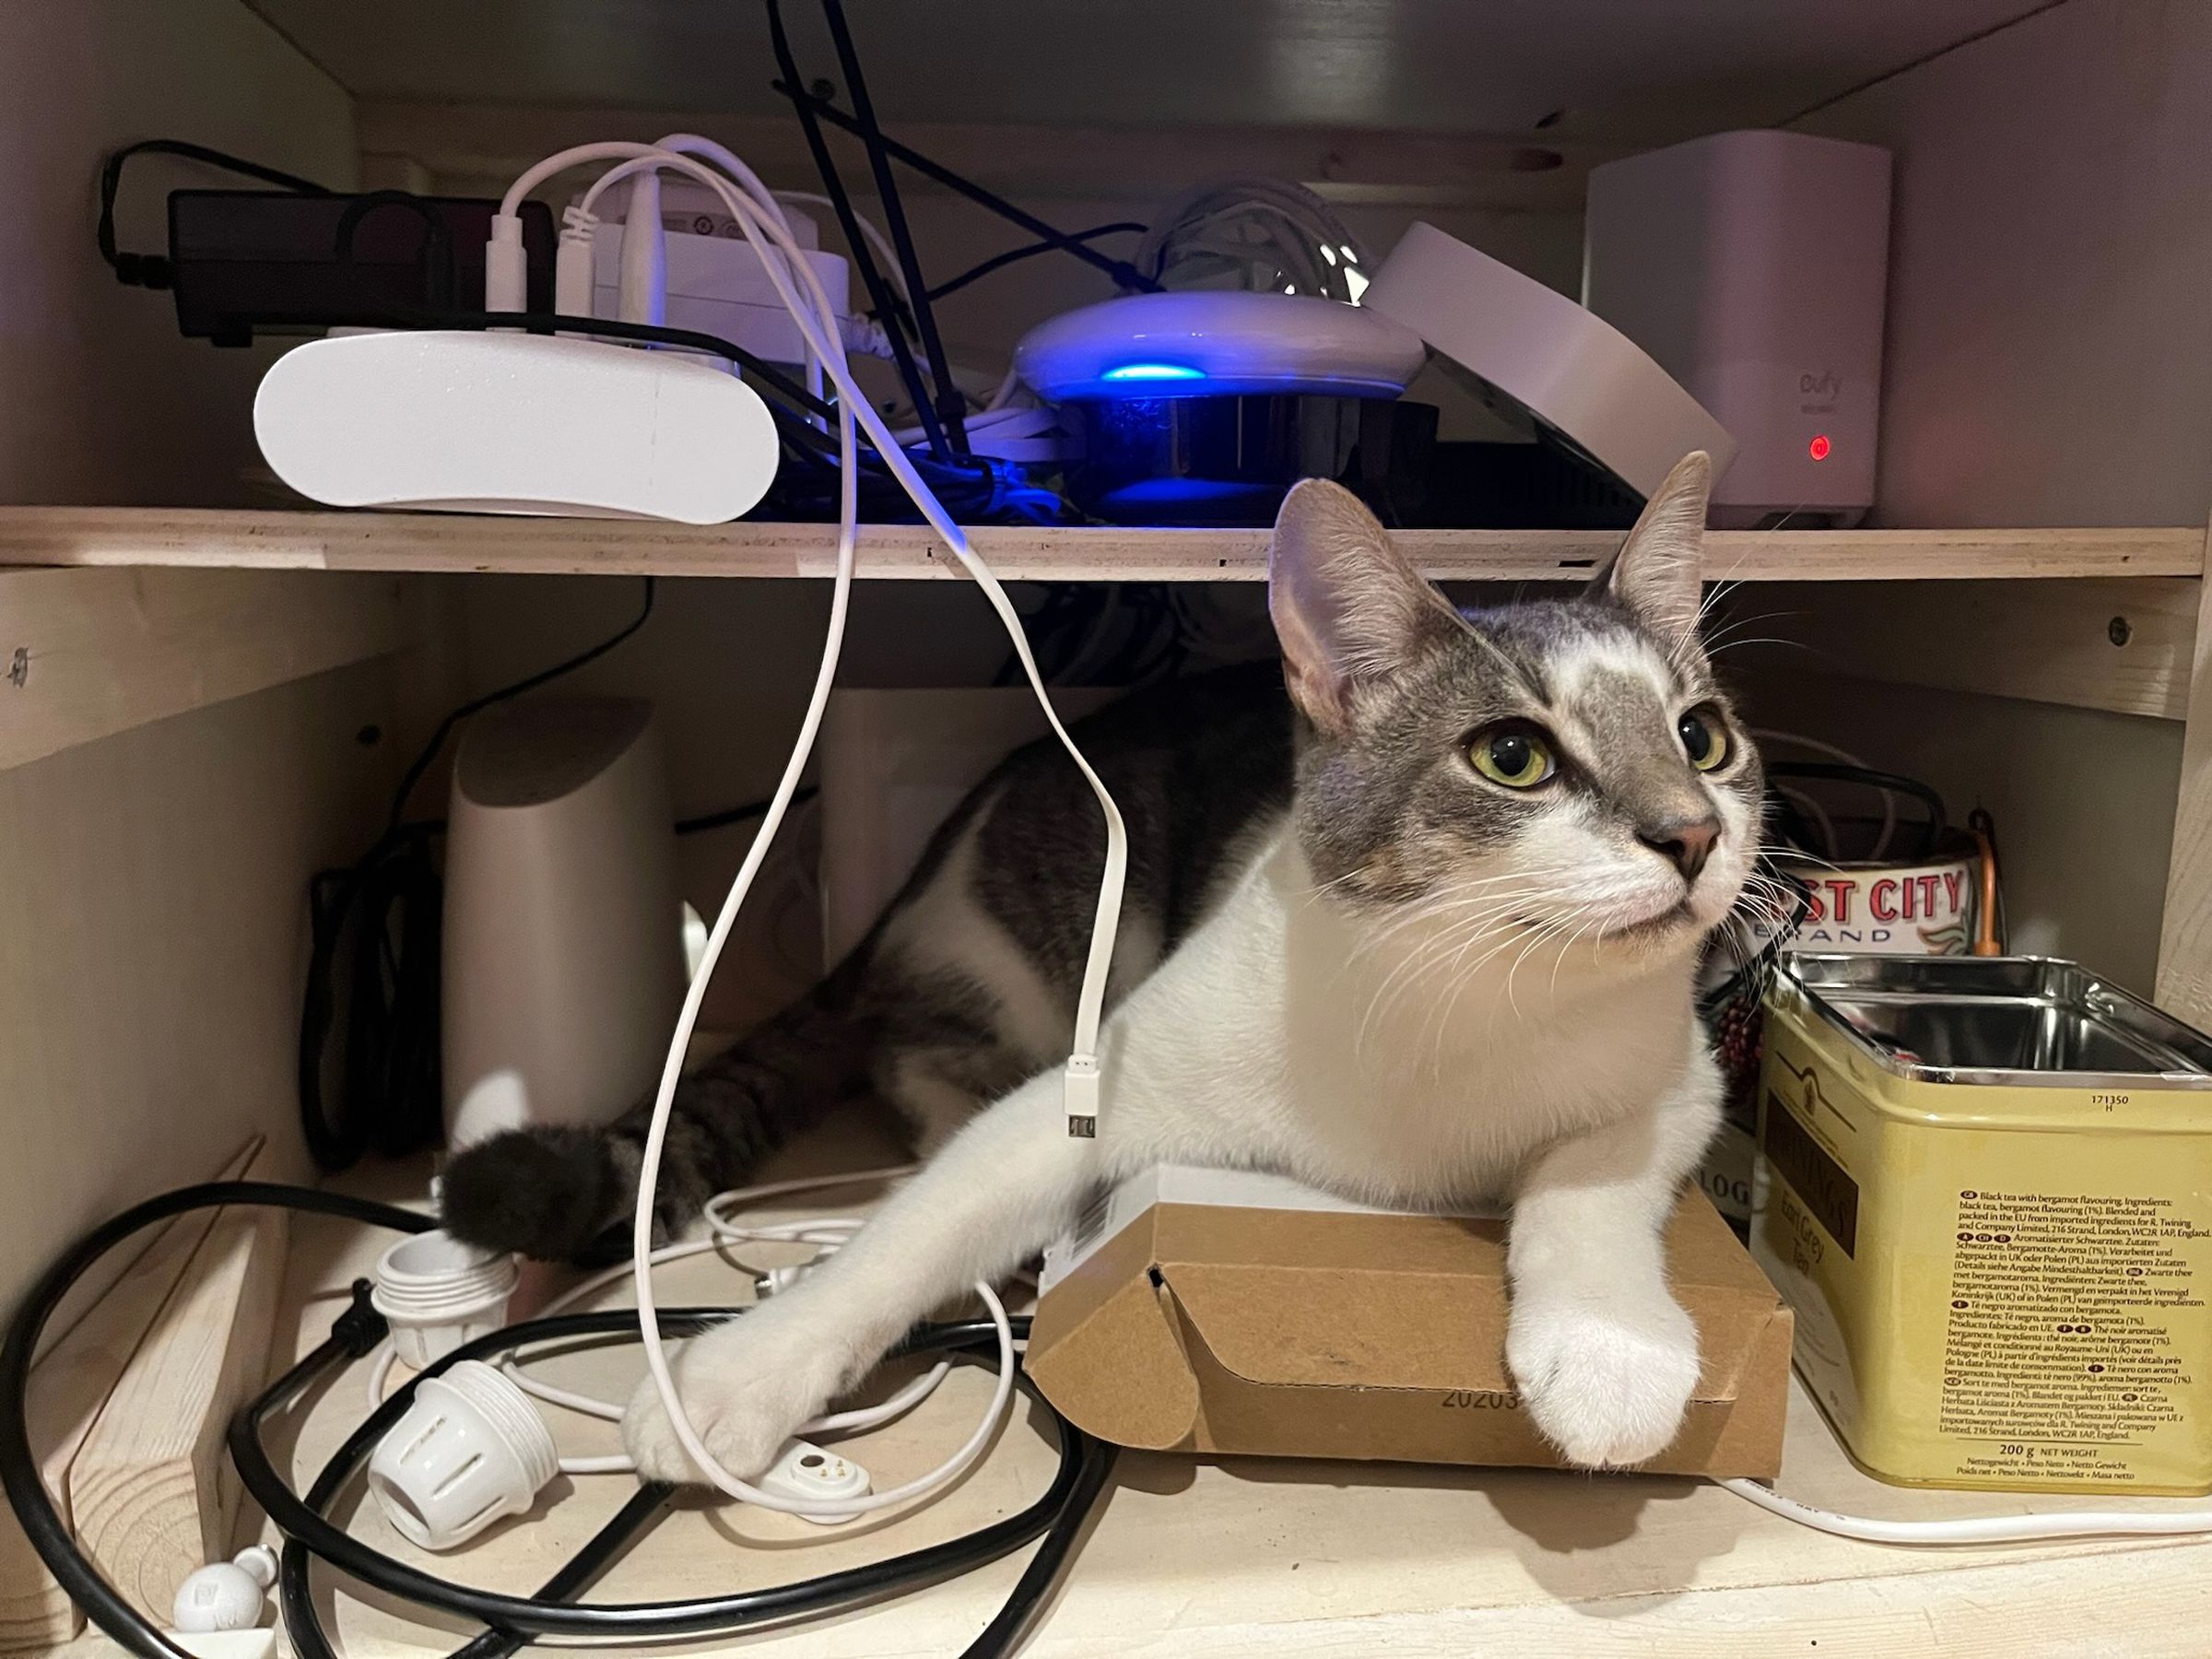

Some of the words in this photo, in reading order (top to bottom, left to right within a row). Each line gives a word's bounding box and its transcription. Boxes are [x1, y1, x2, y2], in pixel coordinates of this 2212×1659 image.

[1869, 869, 1963, 922] CITY
[2092, 1095, 2129, 1105] 171350
[2105, 1104, 2112, 1112] H
[1980, 1192, 2002, 1201] Black
[2019, 1193, 2037, 1202] with
[2038, 1194, 2079, 1205] bergamot
[2080, 1195, 2123, 1207] flavouring.
[2125, 1197, 2173, 1209] Ingredients:
[1960, 1201, 1981, 1210] black
[1983, 1203, 1998, 1212] tea,
[2000, 1203, 2040, 1214] bergamot
[2042, 1204, 2083, 1216] flavouring
[2106, 1207, 2139, 1216] Blended
[2140, 1208, 2156, 1216] and
[1959, 1211, 1988, 1222] packed
[1999, 1212, 2013, 1220] the
[2015, 1213, 2027, 1221] EU
[2028, 1213, 2048, 1222] from
[2050, 1214, 2089, 1225] imported
[2091, 1215, 2136, 1227] ingredients
[2137, 1217, 2149, 1225] for
[2160, 1218, 2192, 1229] Twining
[1958, 1221, 1973, 1229] and
[1975, 1221, 2016, 1233] Company
[2017, 1223, 2050, 1233] Limited,
[2052, 1224, 2066, 1233] 216
[2068, 1225, 2097, 1235] Strand,
[2098, 1226, 2131, 1236] London,
[2132, 1227, 2158, 1236] WC2R
[2178, 1229, 2212, 1240] England.
[1800, 1216, 1825, 1264] Grey
[2014, 1233, 2075, 1243] Aromatisierter
[2007, 1243, 2087, 1256] Bergamotte-Aroma
[2110, 1247, 2154, 1256] Verarbeitet
[2156, 1248, 2172, 1257] und
[1955, 1251, 1997, 1262] abgepackt
[2009, 1252, 2022, 1261] UK
[2023, 1253, 2042, 1262] oder
[2044, 1254, 2067, 1262] Polen
[2068, 1254, 2085, 1264] (PL)
[2101, 1256, 2154, 1268] importierten
[2155, 1258, 2187, 1267] Zutaten
[1954, 1260, 1986, 1271] (Details
[1987, 1262, 2008, 1270] siehe
[2009, 1262, 2041, 1274] Angabe
[2145, 1267, 2173, 1276] Zwarte
[2175, 1268, 2193, 1277] thee
[1972, 1271, 2041, 1284] bergamotaroma.
[2098, 1276, 2126, 1285] Zwarte
[2128, 1277, 2147, 1287] thee,
[1952, 1280, 2020, 1292] bergamotaroma
[2042, 1283, 2085, 1295] Vermengd
[2098, 1285, 2128, 1296] verpakt
[2138, 1287, 2152, 1295] het
[2154, 1287, 2189, 1299] Verenigd
[1952, 1289, 1994, 1301] Koninkrijk
[1996, 1290, 2016, 1301] (UK)
[2036, 1292, 2059, 1301] Polen
[1982, 1303, 2006, 1312] negro
[2007, 1302, 2059, 1311] aromatizado
[2076, 1304, 2122, 1316] bergamota.
[1949, 1319, 1988, 1328] Producto
[1989, 1320, 2028, 1330] fabricado
[2110, 1325, 2126, 1334] noir
[2015, 1314, 2040, 1323] negro,
[2069, 1314, 2080, 1322] de
[2081, 1314, 2125, 1326] bergamota
[2047, 1332, 2060, 1340] thé
[2061, 1332, 2080, 1342] noir,
[1946, 1347, 1980, 1358] Pologne
[1981, 1348, 1997, 1358] (PL)
[2004, 1349, 2027, 1360] partir
[2119, 1353, 2137, 1363] (voir
[2055, 1342, 2110, 1354] Royaume-Uni
[2111, 1344, 2131, 1354] (UK)
[1945, 1357, 1956, 1365] de
[1965, 1358, 1984, 1366] date
[1985, 1359, 2009, 1367] limite
[2010, 1359, 2020, 1368] de
[1963, 1378, 1980, 1386] Sort
[1991, 1379, 2010, 1387] med
[2011, 1379, 2050, 1391] bergamot
[2125, 1373, 2173, 1385] bergamotto
[1943, 1386, 1983, 1398] bergamot
[2032, 1390, 2062, 1398] Blandet
[2064, 1393, 2074, 1401] og
[1974, 1426, 1988, 1434] 216
[2052, 1428, 2077, 1437] WC2R
[2097, 1430, 2130, 1441] England.
[2070, 1420, 2100, 1431] Twining
[2101, 1421, 2117, 1429] and
[2118, 1421, 2157, 1433] Company
[2000, 1444, 2024, 1456] 200
[2027, 1448, 2035, 1459] g
[2040, 1448, 2059, 1457] NET
[2061, 1449, 2099, 1458] WEIGHT
[1967, 1456, 2020, 1468] Nettogewicht
[2026, 1458, 2044, 1467] Peso
[2045, 1459, 2064, 1467] Neto
[2071, 1460, 2094, 1468] Netto
[2095, 1461, 2127, 1470] Gewicht
[1957, 1466, 1978, 1475] Poids
[1999, 1467, 2016, 1476] Peso
[2017, 1468, 2040, 1477] Netto
[2092, 1470, 2113, 1479] Masa
